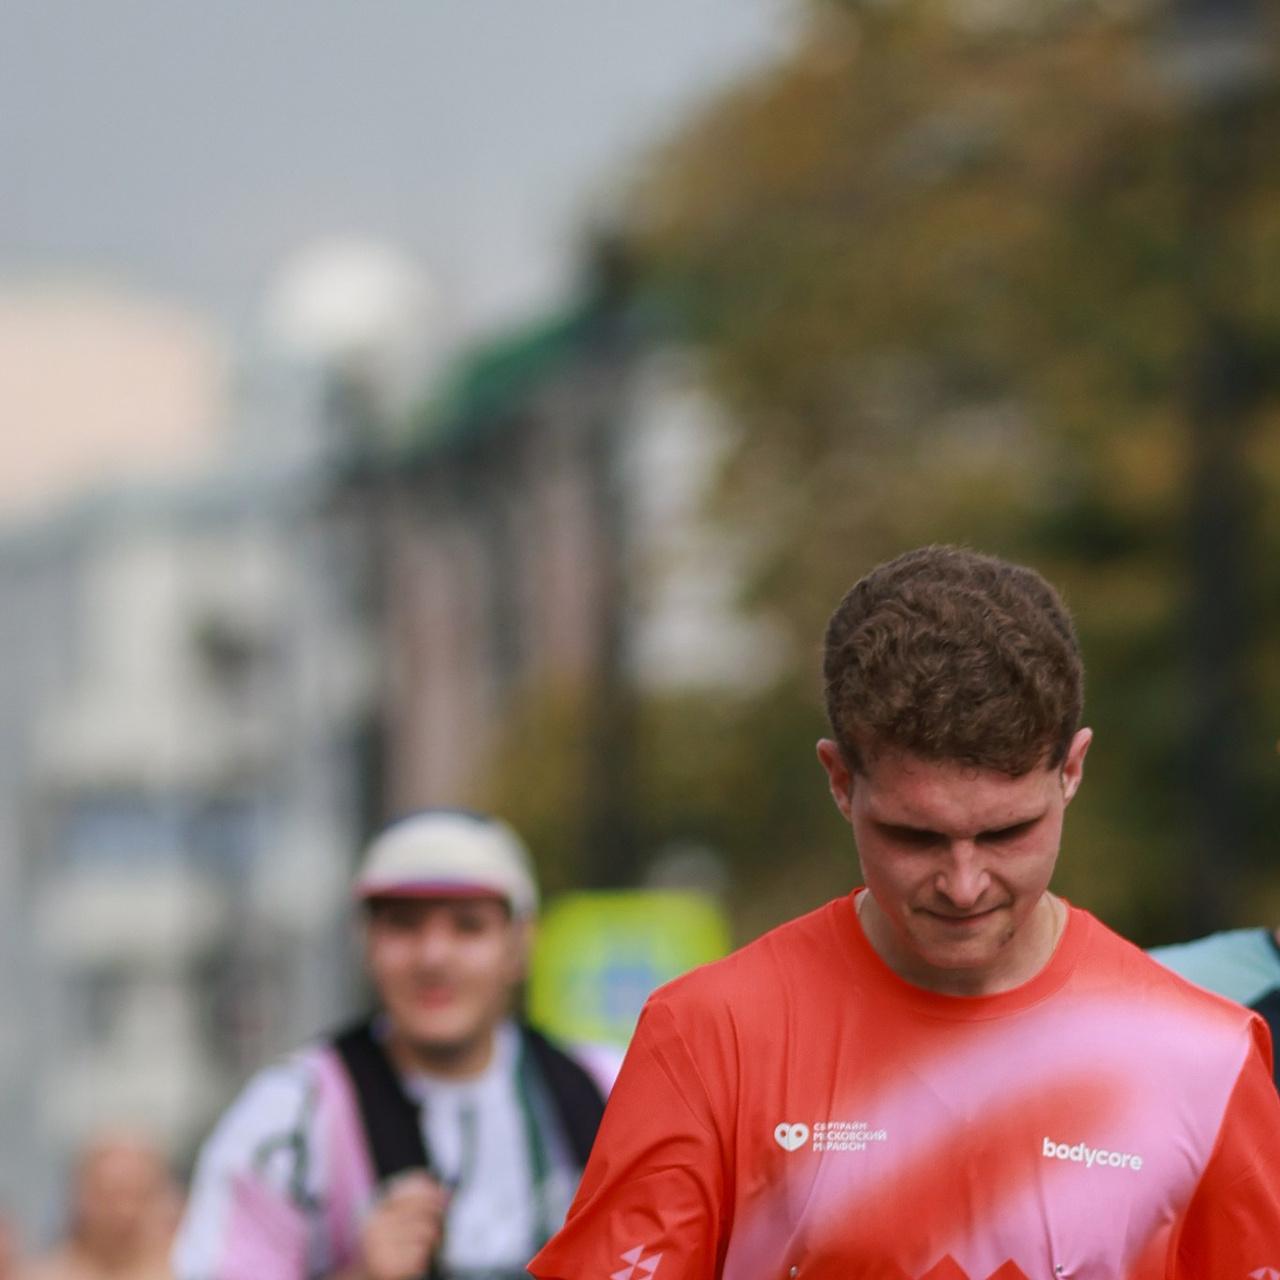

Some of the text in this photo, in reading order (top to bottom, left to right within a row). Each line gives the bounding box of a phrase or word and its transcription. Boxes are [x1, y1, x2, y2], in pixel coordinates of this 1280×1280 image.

[813, 1121, 867, 1131] СБРПРАЙМ
[813, 1129, 887, 1141] МСКОВСКИЙ
[813, 1141, 866, 1152] МРАФОН
[1042, 1136, 1143, 1171] bodycore
